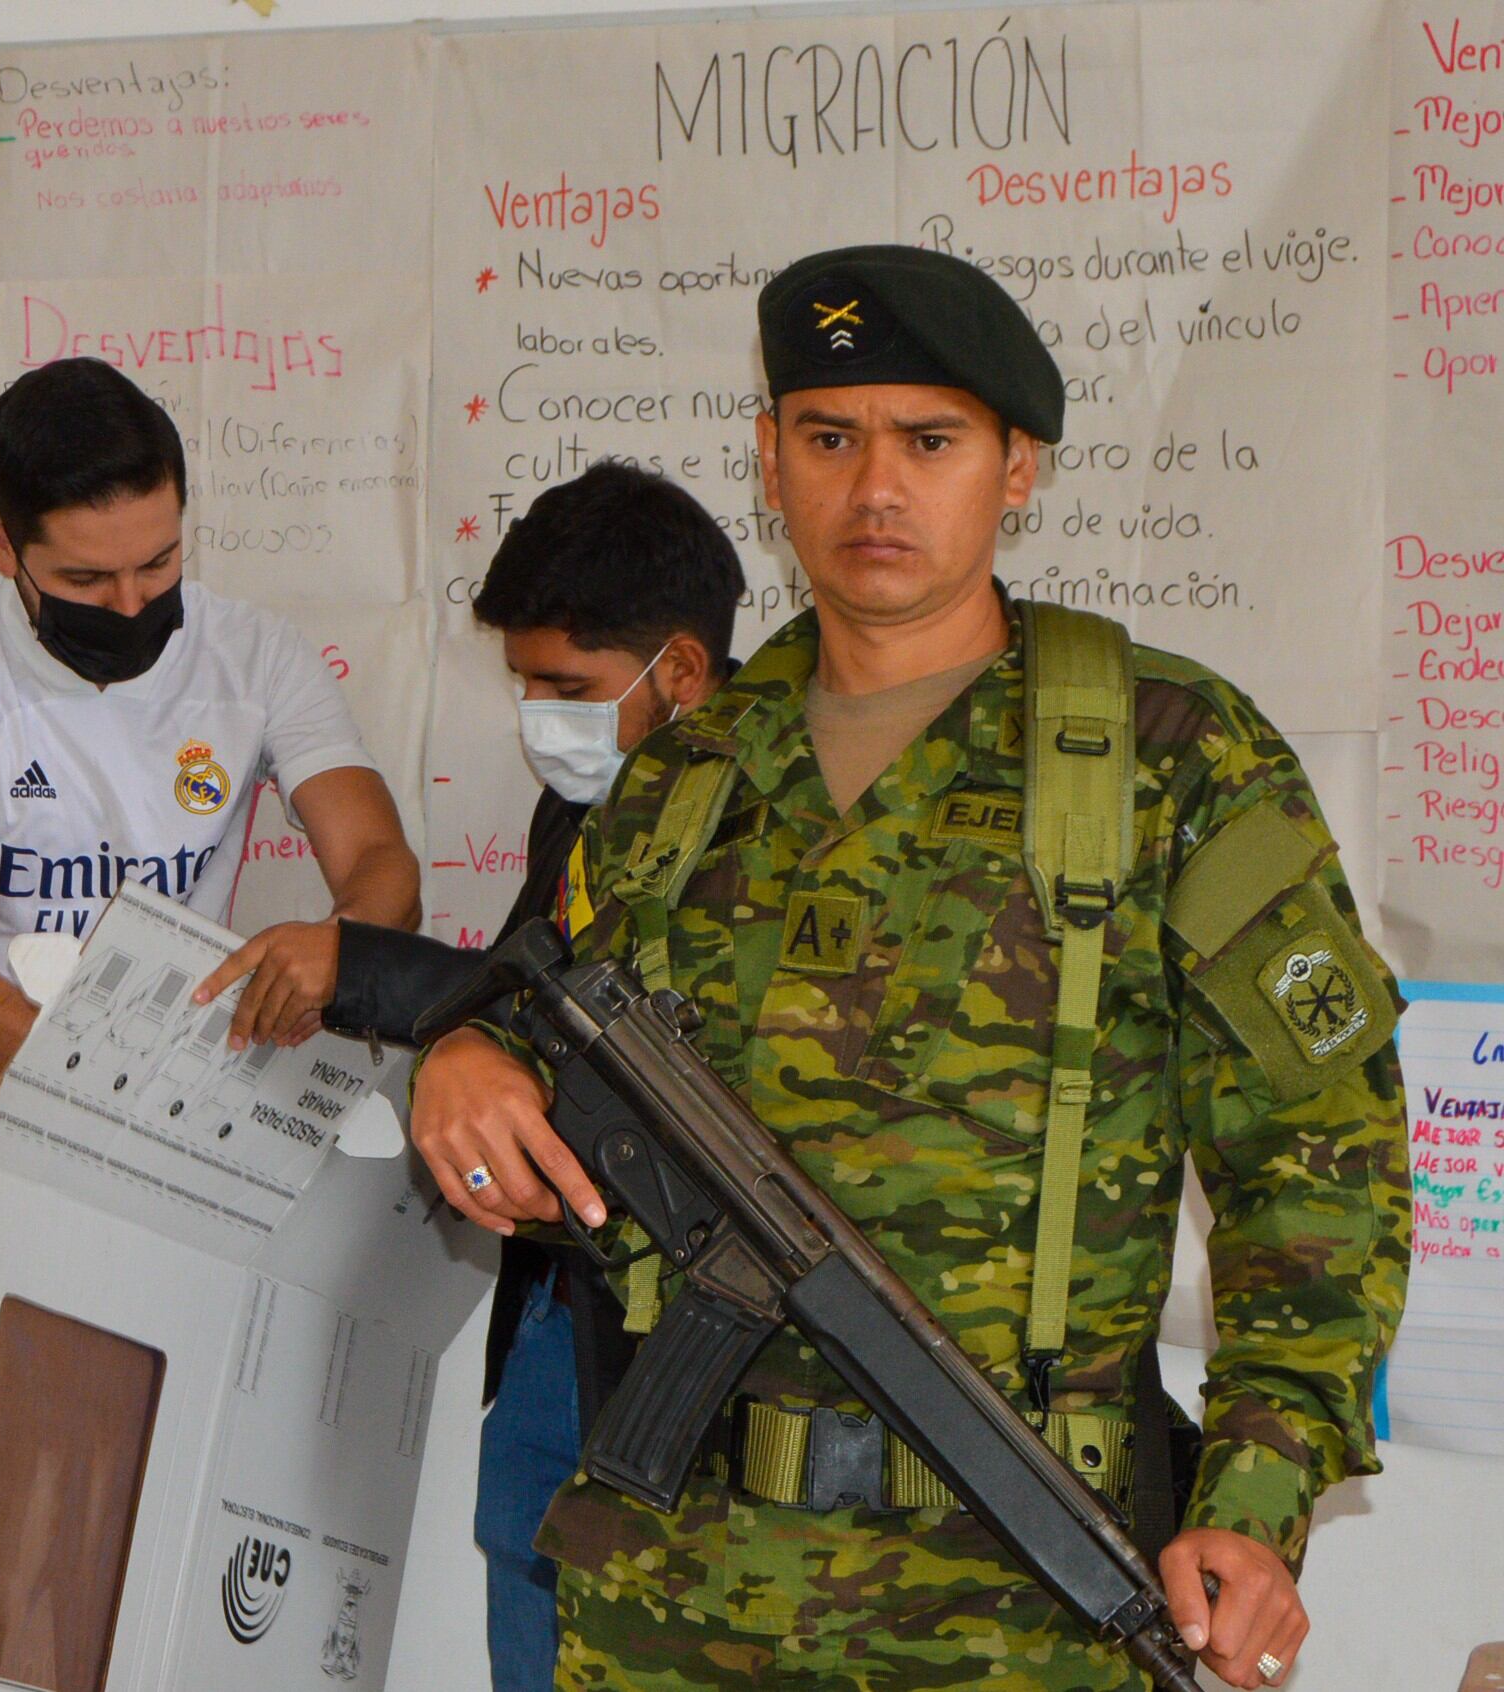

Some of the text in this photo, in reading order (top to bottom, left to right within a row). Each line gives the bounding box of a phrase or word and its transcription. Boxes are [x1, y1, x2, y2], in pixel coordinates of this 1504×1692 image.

[1422, 18, 1504, 74] Ven
[656, 16, 1071, 168] MIGRACIÓN
[18, 106, 153, 138] Perdemos
[1414, 96, 1504, 148] Mejo
[966, 149, 1234, 224] Desventajas
[484, 171, 661, 248] Ventajas
[517, 248, 644, 291] Nuevas
[1084, 228, 1209, 282] durante
[1222, 229, 1254, 273] el
[1262, 227, 1358, 283] viaje.
[516, 322, 665, 357] laborales.
[1085, 299, 1157, 351] del
[498, 363, 777, 423] Conocer nuev
[680, 455, 702, 479] e
[1153, 432, 1198, 472] de
[1222, 429, 1259, 471] la
[1062, 498, 1103, 537] de
[1119, 503, 1214, 540] vida.
[1005, 566, 1256, 610] criminación.
[1417, 697, 1504, 730] Desc
[10, 784, 57, 799] adidas
[1416, 789, 1504, 834] Riesg
[944, 802, 1025, 833] EJE
[787, 904, 854, 958] A+
[309, 1058, 364, 1097] LA URNA
[249, 1100, 288, 1131] PARA
[297, 1088, 346, 1120] ARMAR
[1424, 1086, 1504, 1120] VENTAJ
[282, 1116, 327, 1148] PASOS
[1413, 1151, 1479, 1175] MEJOR
